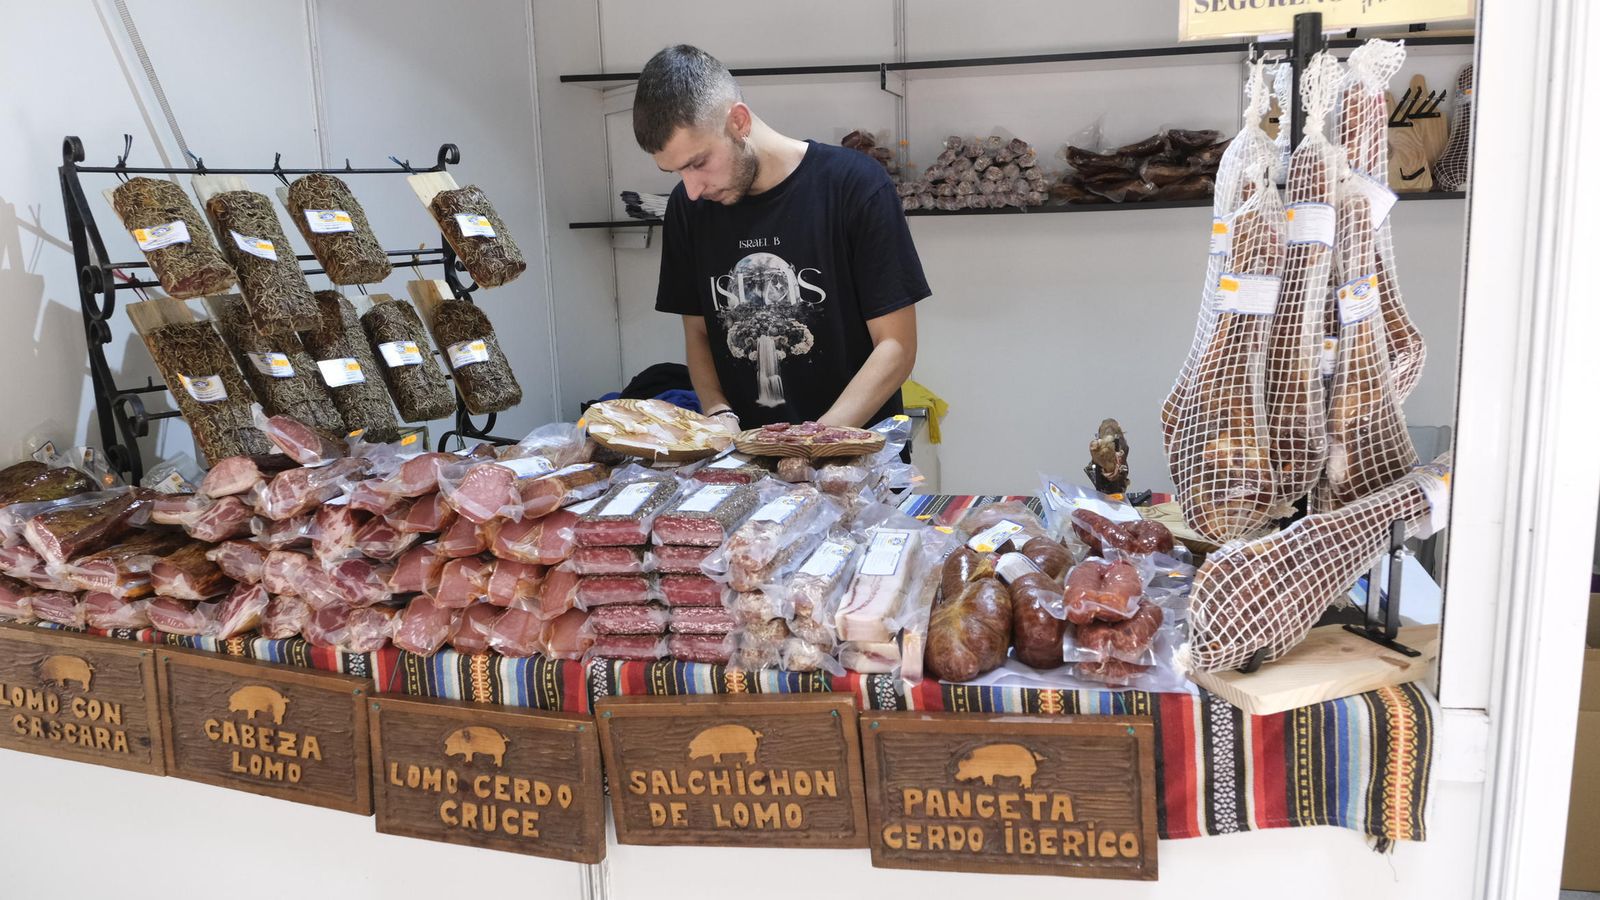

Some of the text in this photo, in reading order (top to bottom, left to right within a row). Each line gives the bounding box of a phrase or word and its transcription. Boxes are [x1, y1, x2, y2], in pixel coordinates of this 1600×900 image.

[1194, 0, 1340, 13] SEGU
[738, 236, 781, 249] ISRAEL B
[0, 684, 122, 726] LOMO CON
[13, 714, 129, 754] CASCARA
[204, 718, 322, 761] CABEZA
[232, 751, 302, 783] LOMO
[390, 761, 573, 809] LOMO CERDO
[439, 799, 540, 838] CRUCE
[651, 802, 802, 830] DE LOMO
[903, 788, 1075, 822] PANCETA
[882, 824, 984, 852] CERDO
